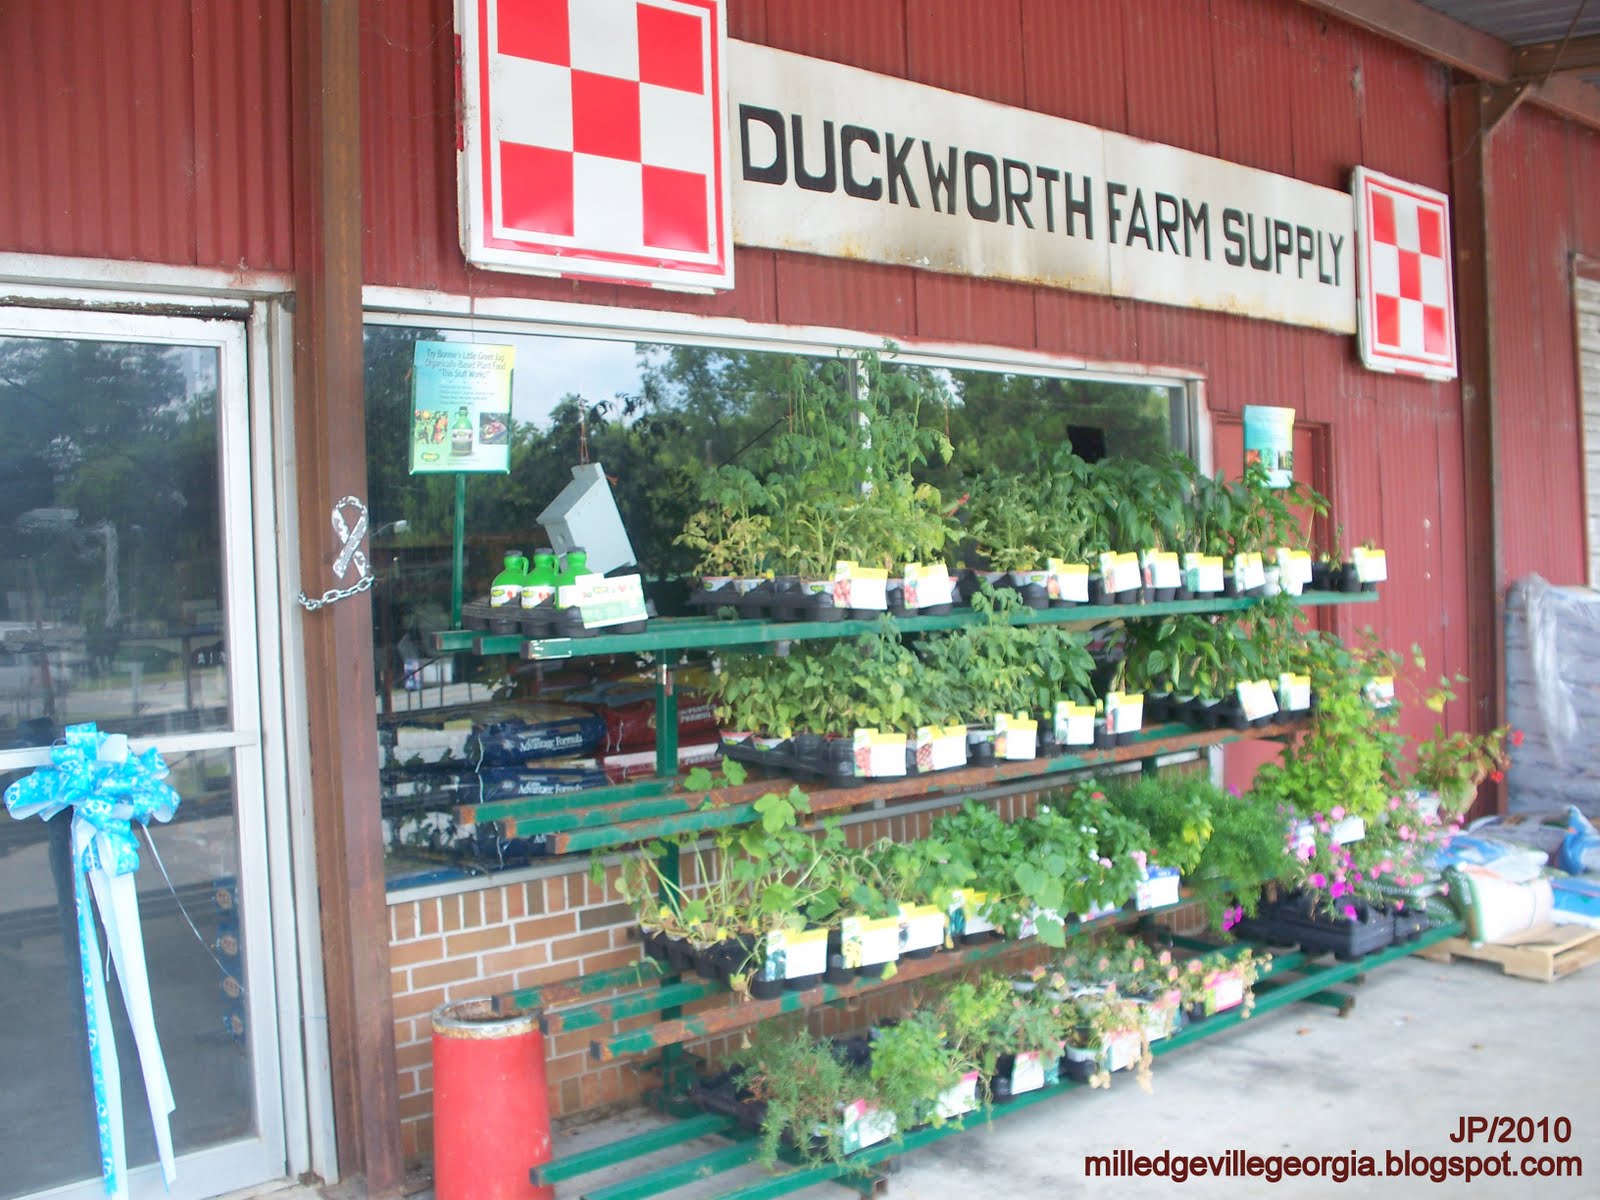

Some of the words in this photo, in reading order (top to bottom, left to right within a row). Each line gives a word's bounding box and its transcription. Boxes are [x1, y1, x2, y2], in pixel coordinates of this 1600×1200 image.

[739, 103, 1093, 240] DUCKWORTH
[1108, 182, 1211, 261] FARM
[1223, 207, 1345, 287] SUPPLY
[555, 733, 583, 746] Formula
